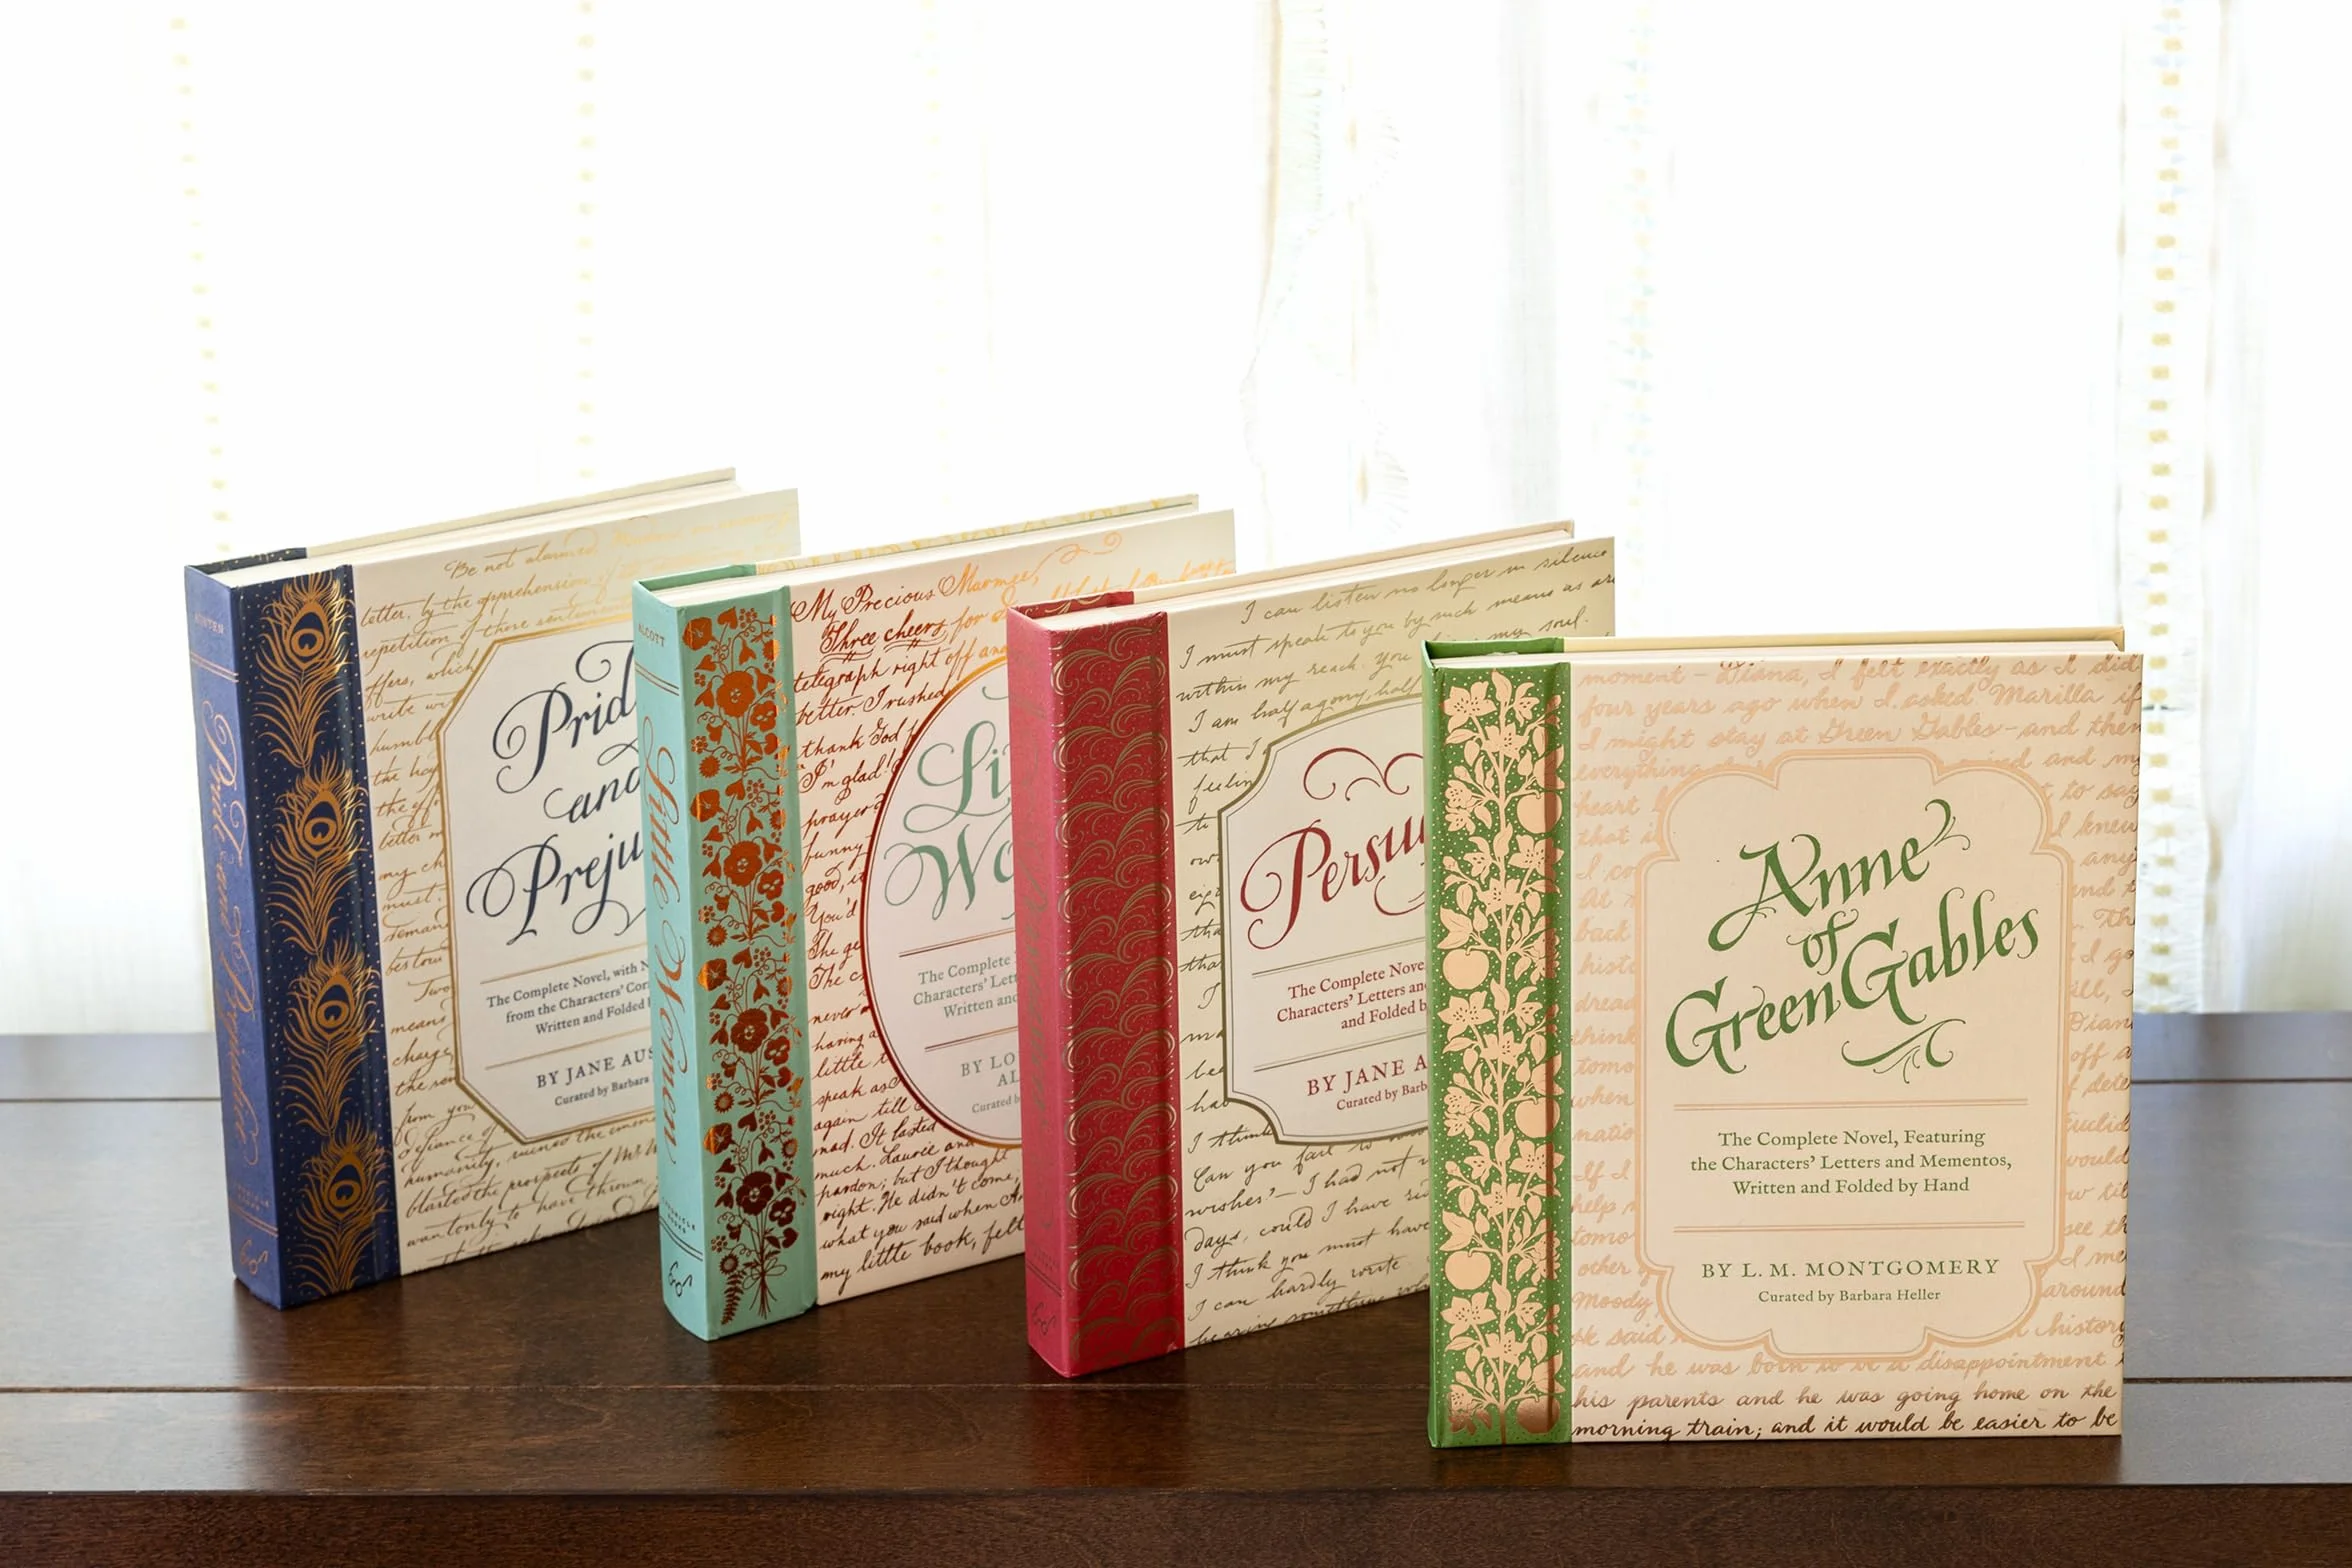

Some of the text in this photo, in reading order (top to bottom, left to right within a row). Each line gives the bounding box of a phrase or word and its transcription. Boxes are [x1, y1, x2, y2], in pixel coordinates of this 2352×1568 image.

[789, 588, 837, 624] My
[841, 583, 936, 615] Precious
[1241, 600, 1256, 625] I
[1263, 606, 1304, 620] can
[1312, 584, 1378, 612] listen
[820, 606, 988, 654] Three cheers for
[793, 637, 978, 696] telegraph right off
[643, 715, 681, 910] Little
[466, 831, 645, 946] Preju
[1708, 798, 1970, 952] Anne
[1786, 908, 1860, 976] of
[487, 962, 642, 1009] The Complete Novel, with
[918, 956, 1011, 986] The Complete
[1288, 984, 1316, 1000] The
[1320, 969, 1386, 994] Complete
[1665, 887, 2040, 1075] Green Gables
[943, 999, 994, 1019] Written
[1357, 984, 1406, 1006] Letters
[506, 1010, 536, 1025] from
[538, 1002, 557, 1016] the
[536, 998, 645, 1036] Written and Folded
[1341, 1014, 1366, 1029] and
[1369, 1002, 1416, 1023] Folded
[654, 919, 689, 1165] Women
[536, 1070, 560, 1090] BY
[565, 1056, 616, 1087] JANE
[960, 1052, 1016, 1078] BY LO
[1307, 1054, 1428, 1096] BY JANE A
[554, 1075, 650, 1107] Curated by Barbara
[972, 1097, 1011, 1114] Curated
[1336, 1080, 1428, 1111] Curated by Barb
[1718, 1128, 1985, 1150] The Complete Novel, Featuring
[893, 1165, 926, 1186] but
[1691, 1156, 1717, 1171] the
[1821, 1155, 1881, 1170] Letters
[1885, 1154, 1915, 1169] and
[1919, 1153, 2012, 1170] Mementos,
[877, 1190, 902, 1216] He
[1733, 1176, 1970, 1197] Written and Folded by Hand
[819, 1198, 997, 1250] what you said when
[1345, 1197, 1392, 1217] have
[820, 1214, 1024, 1296] my little book, felt
[1185, 1263, 1204, 1290] I
[1207, 1250, 1272, 1281] think
[1271, 1250, 1311, 1284] you
[1387, 1215, 1430, 1236] have
[1701, 1258, 2000, 1278] BY L. M. MONTGOMERY
[1187, 1299, 1207, 1322] I
[1214, 1296, 1259, 1312] can
[1266, 1269, 1347, 1305] hardly
[1351, 1254, 1407, 1280] write
[1758, 1288, 1941, 1305] Curated by Barbara Heller
[1571, 1379, 2119, 1421] his parents and he was going home on the
[1571, 1405, 2119, 1442] morning train; and it would be easier to be
